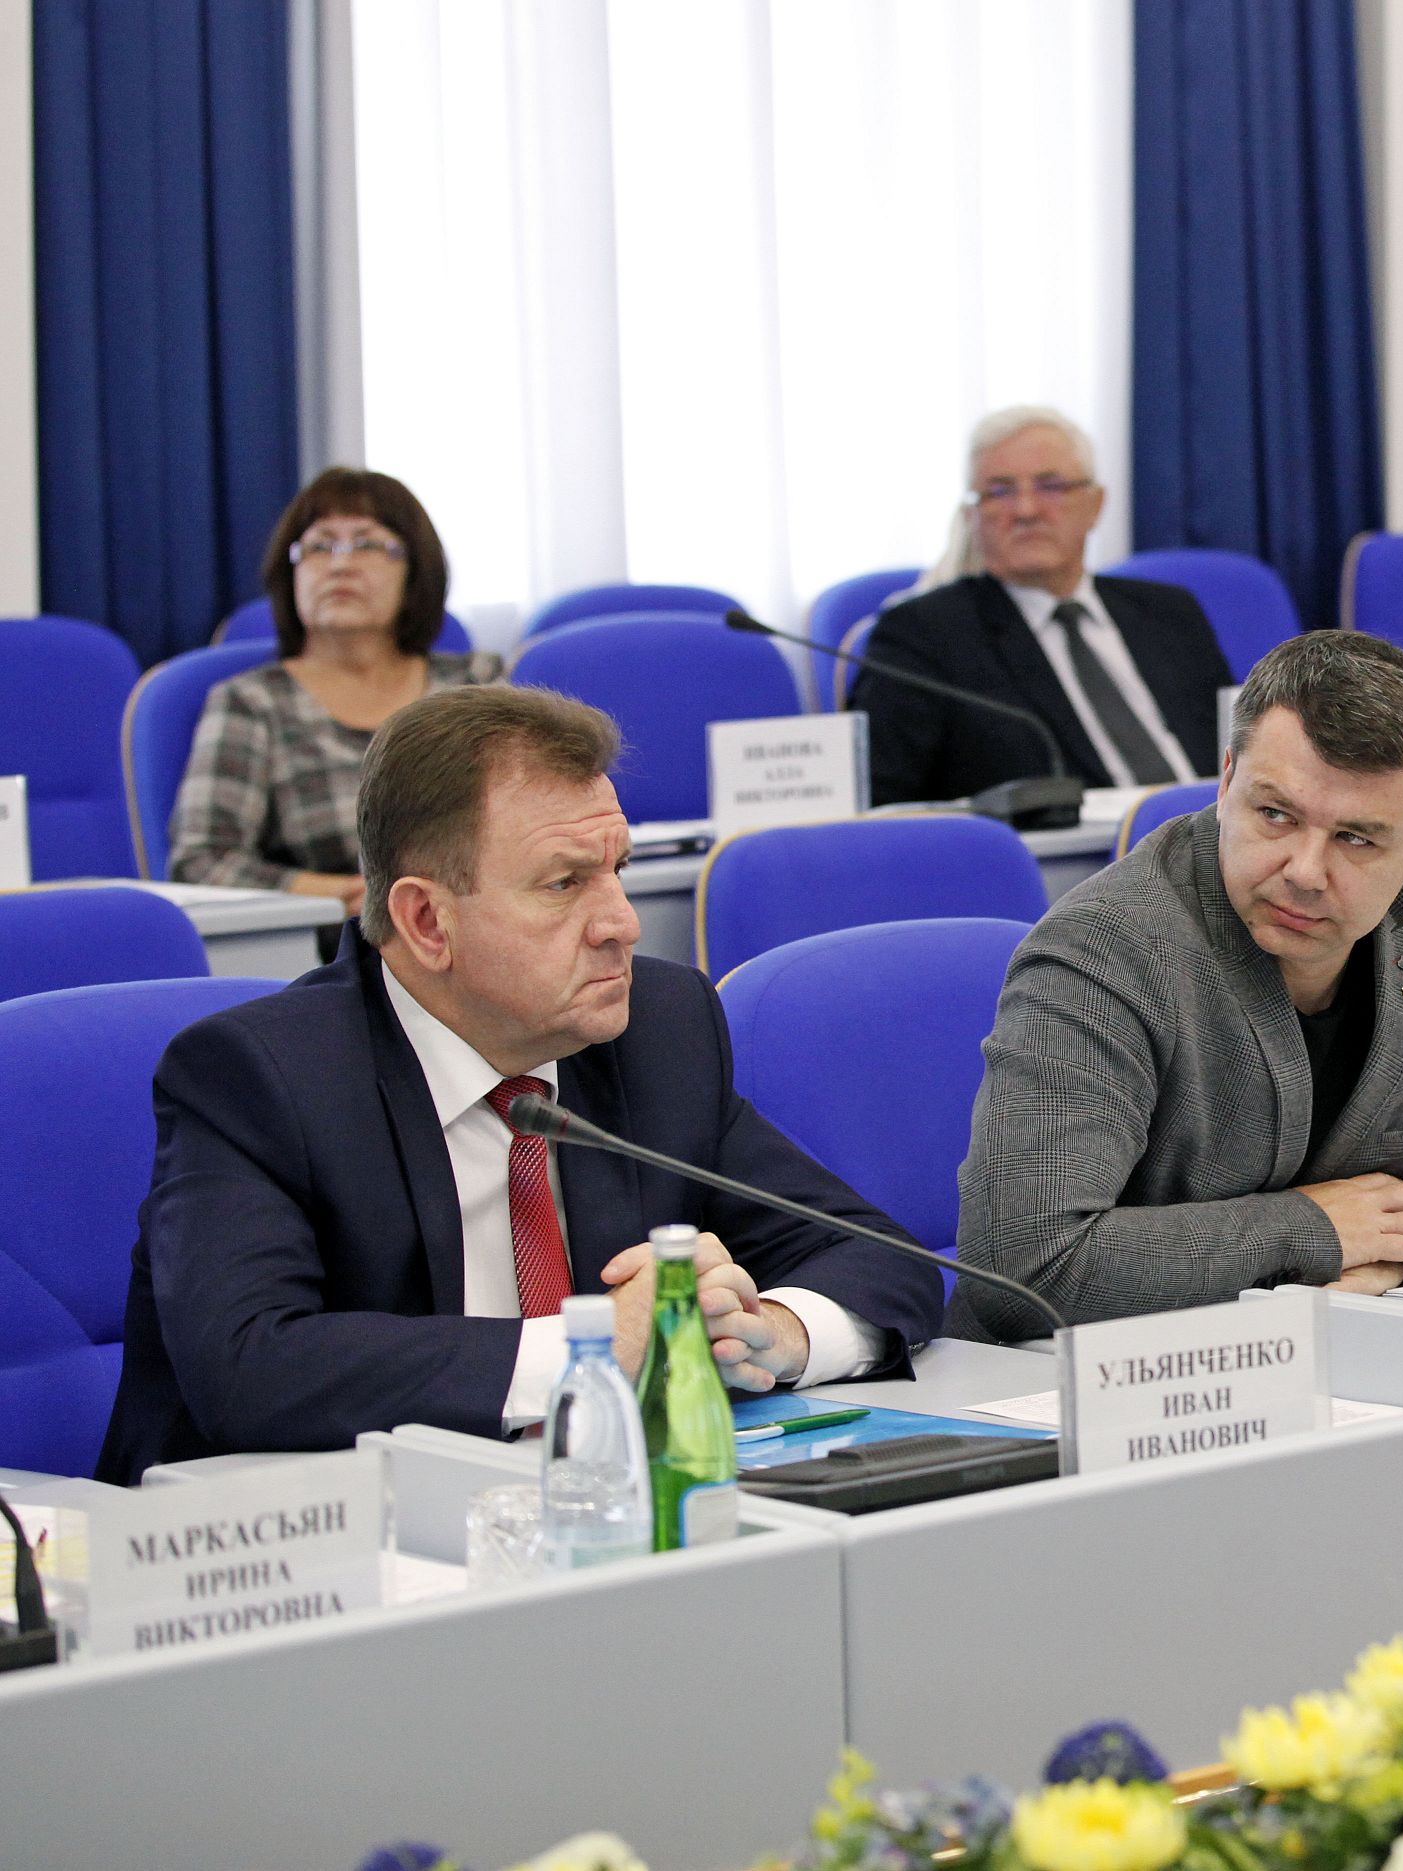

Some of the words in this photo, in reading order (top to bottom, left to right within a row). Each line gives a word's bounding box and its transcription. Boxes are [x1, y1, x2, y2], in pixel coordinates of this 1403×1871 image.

[1098, 1337, 1294, 1389] УЛЬЯНЧЕНКО
[1163, 1386, 1232, 1418] ИВАН
[1127, 1419, 1268, 1462] ИВАНОВИЧ
[127, 1500, 347, 1568] МАРКАСЬЯН
[186, 1561, 292, 1601] ИРИНА
[134, 1592, 344, 1652] ВИКТОРОВНА
